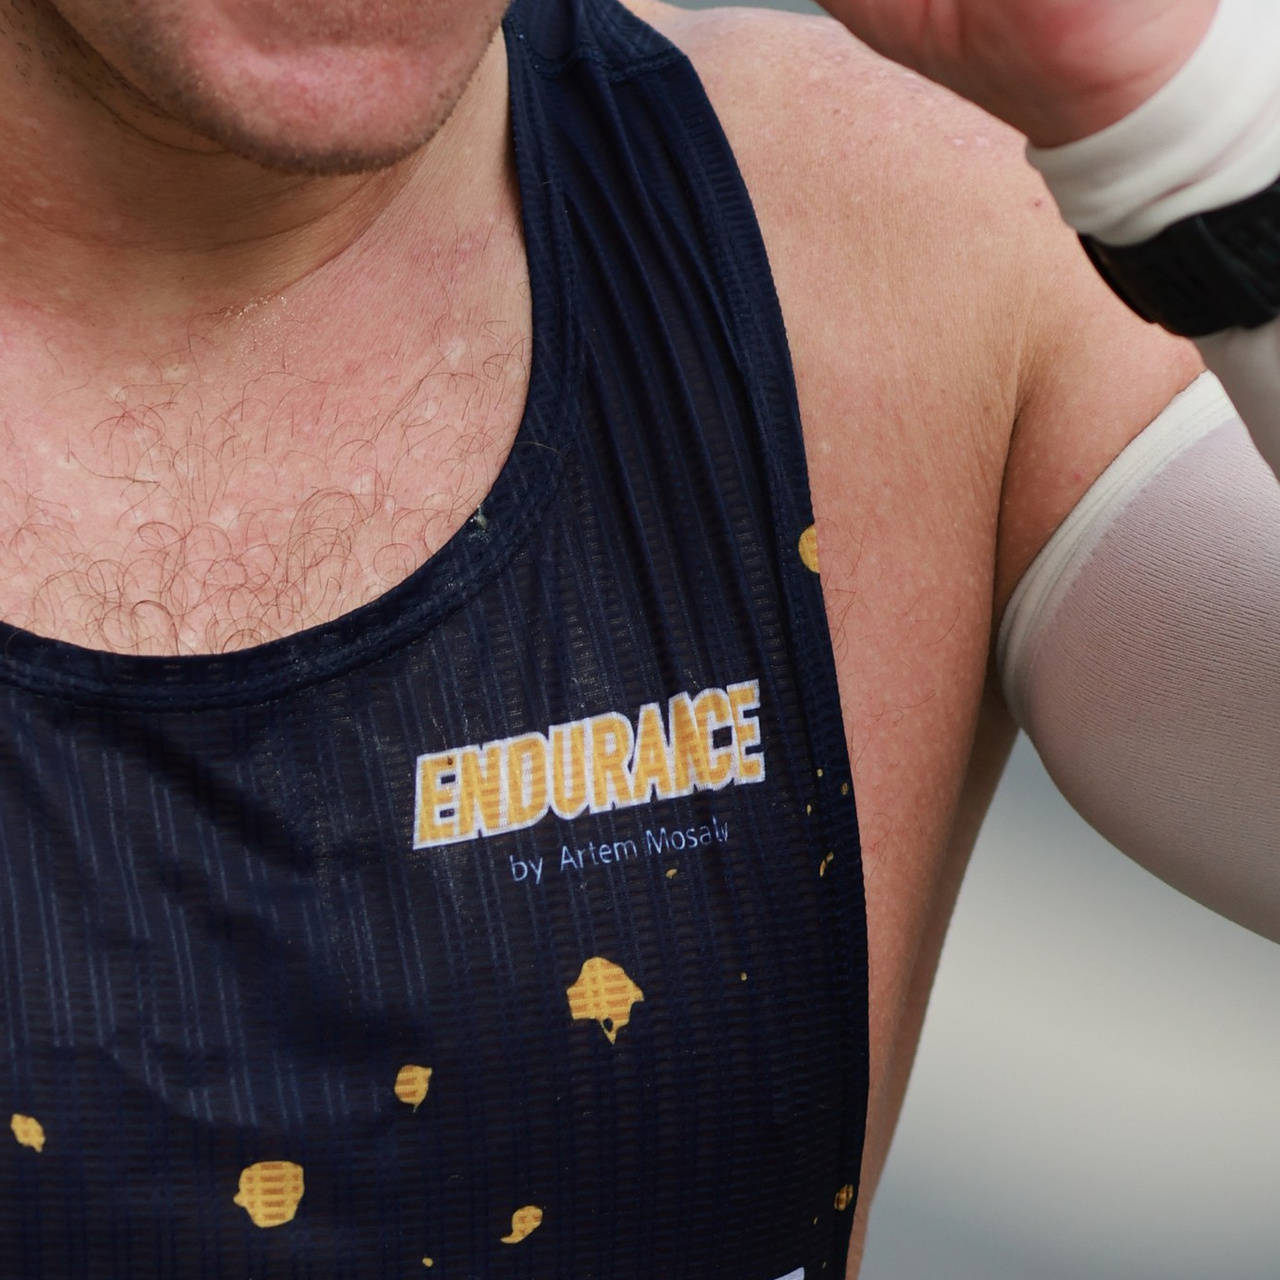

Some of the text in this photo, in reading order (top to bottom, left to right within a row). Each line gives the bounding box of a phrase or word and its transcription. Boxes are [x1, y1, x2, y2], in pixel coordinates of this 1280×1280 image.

[413, 679, 766, 850] ENDURANCE
[509, 854, 543, 885] by
[560, 841, 638, 871] Artem
